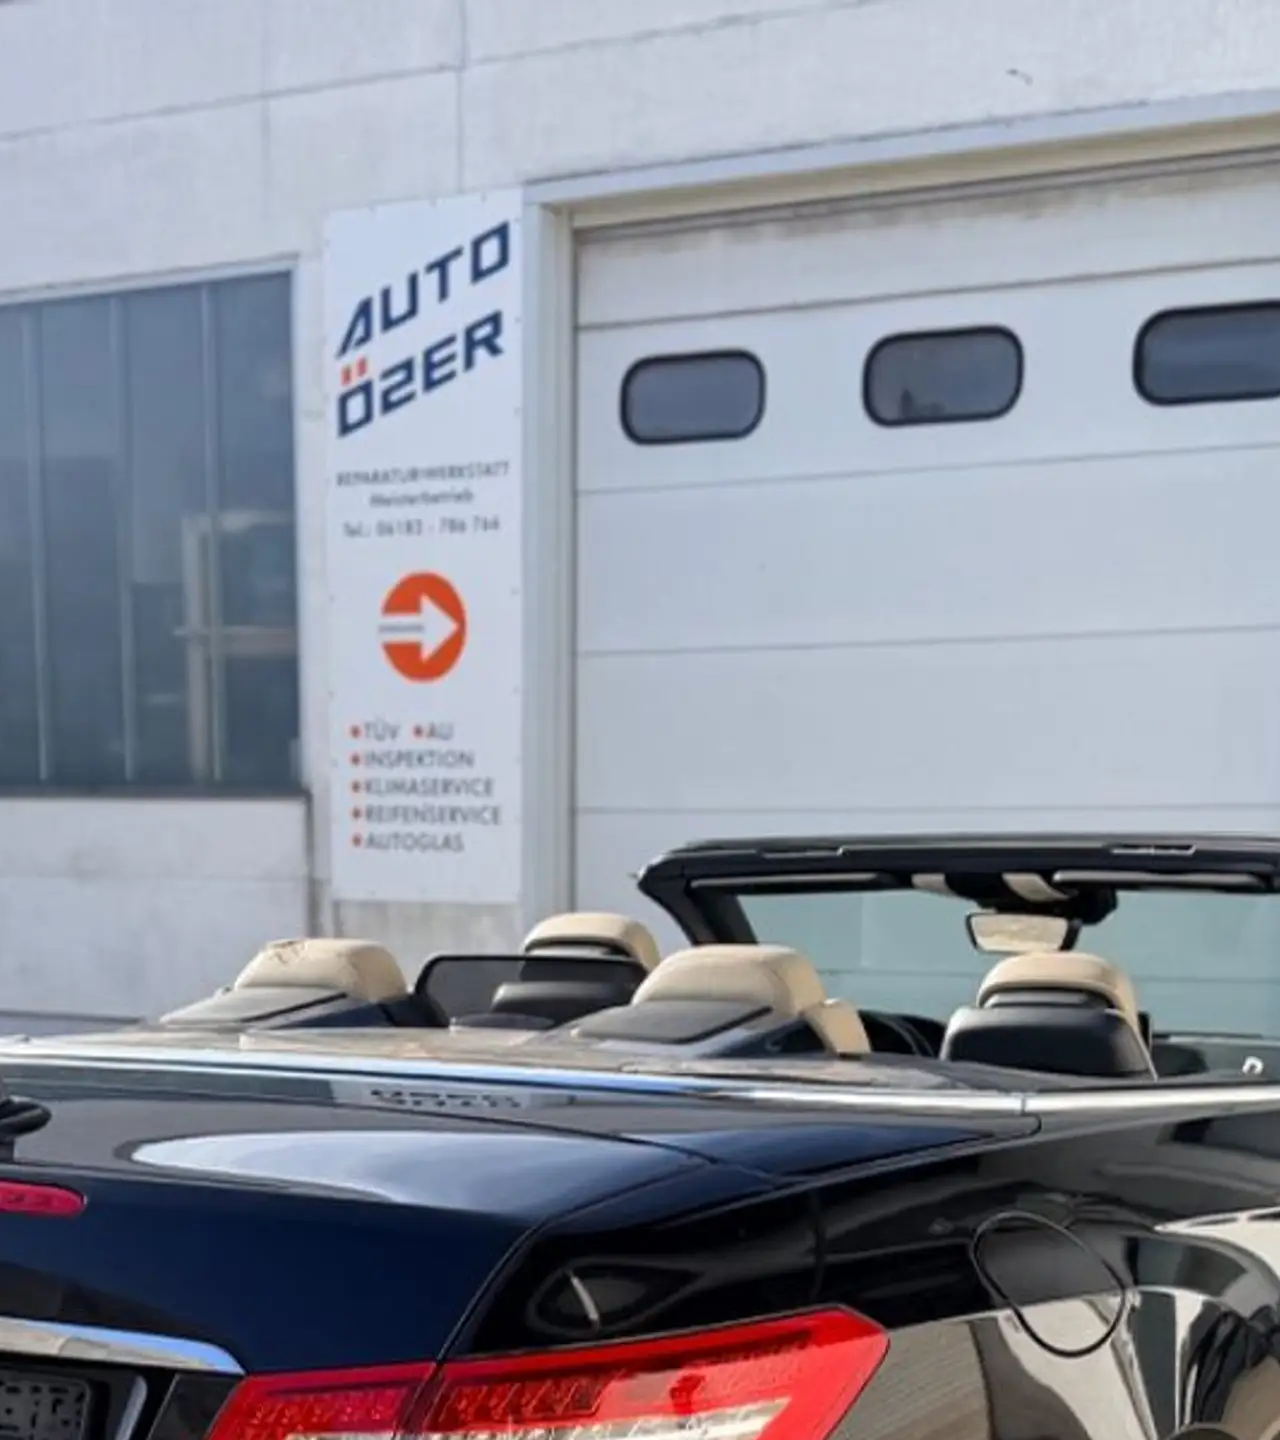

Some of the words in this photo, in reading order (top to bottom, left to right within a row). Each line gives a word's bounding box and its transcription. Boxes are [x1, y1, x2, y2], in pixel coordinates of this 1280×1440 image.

[337, 220, 510, 359] AUTO
[364, 717, 400, 741] TÜV
[427, 722, 454, 740] AU
[365, 749, 474, 768] INSPEKTION
[365, 777, 494, 796] KLIMASERVICE
[365, 804, 501, 825] REIFENSERVICE
[365, 831, 464, 851] AUTOGLAS
